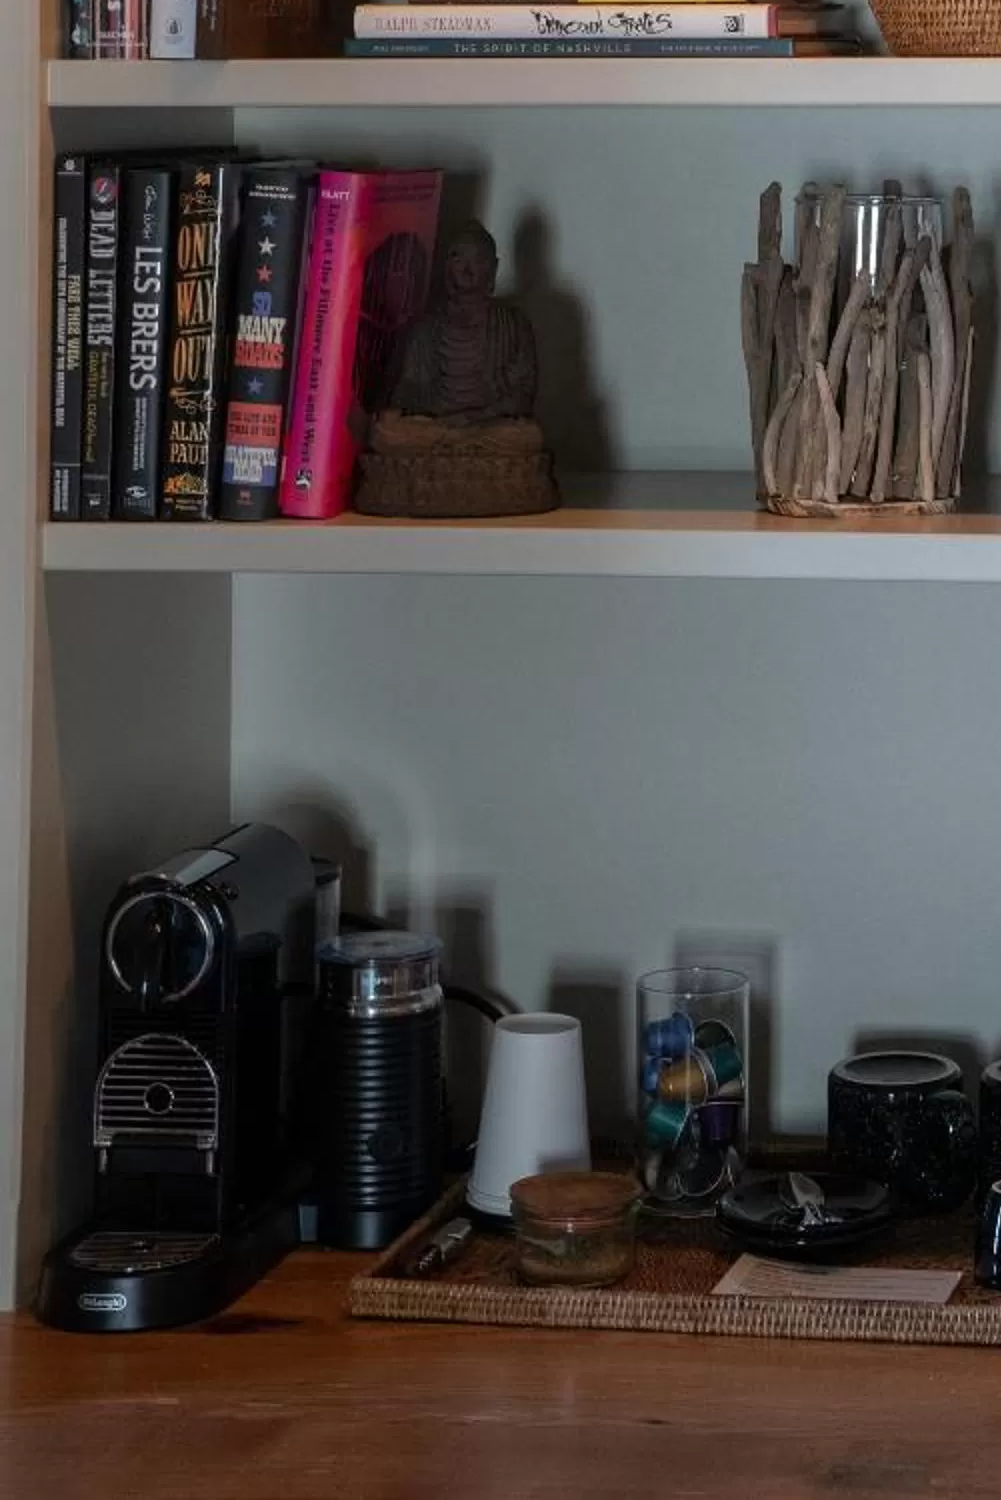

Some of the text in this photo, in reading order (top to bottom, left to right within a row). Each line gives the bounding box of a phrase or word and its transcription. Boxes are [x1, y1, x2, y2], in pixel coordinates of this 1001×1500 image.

[87, 208, 116, 345] DEAD LETTERS
[133, 245, 163, 294] LES
[67, 274, 81, 303] FARE
[129, 301, 160, 391] BRERS
[237, 314, 287, 345] MANY
[300, 203, 341, 463] Live at the Fillmore East and West
[67, 337, 81, 371] WELL
[234, 340, 284, 370] ROADS
[169, 420, 208, 441] ALAN
